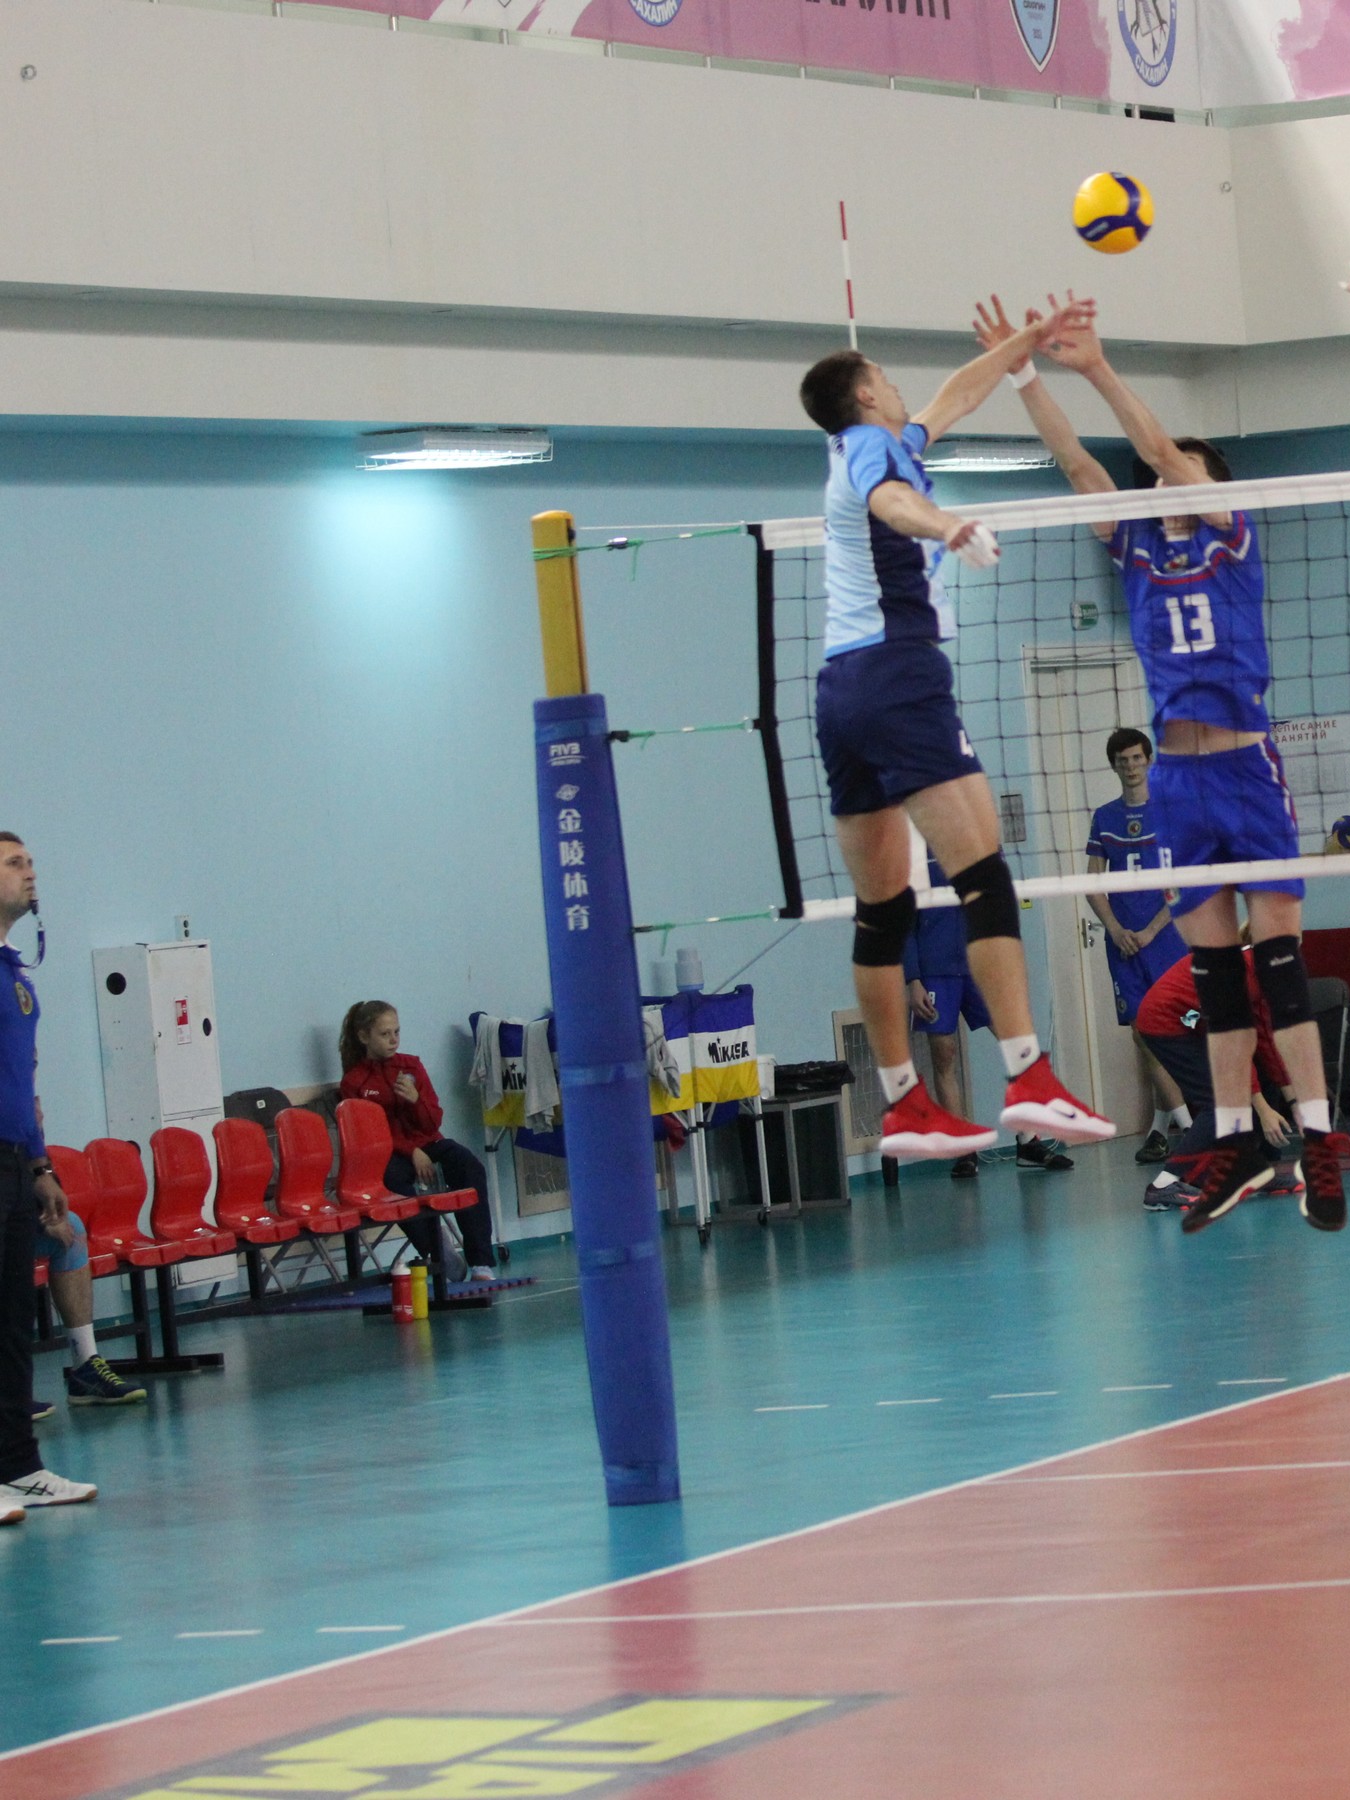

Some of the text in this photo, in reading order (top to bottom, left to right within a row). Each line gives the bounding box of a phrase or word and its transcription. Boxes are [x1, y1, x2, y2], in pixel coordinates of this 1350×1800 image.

[1166, 593, 1216, 653] 13
[559, 808, 590, 931] 金陵体育
